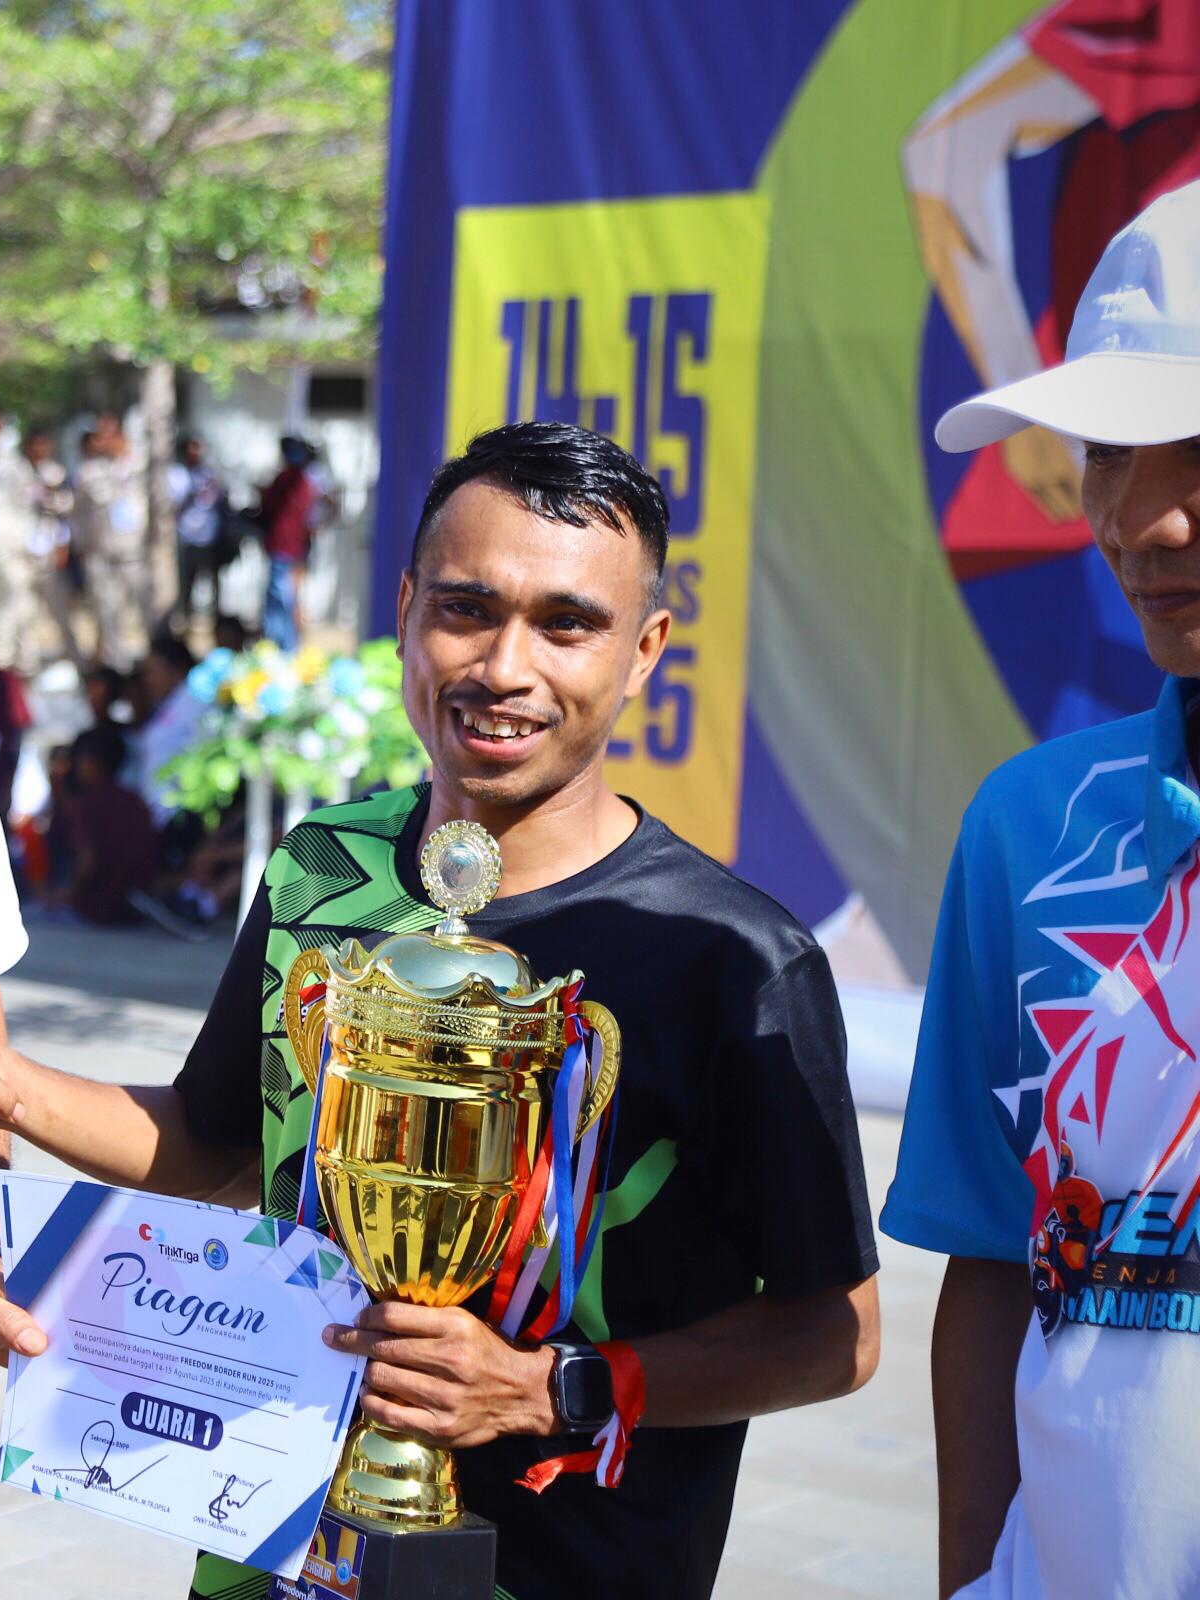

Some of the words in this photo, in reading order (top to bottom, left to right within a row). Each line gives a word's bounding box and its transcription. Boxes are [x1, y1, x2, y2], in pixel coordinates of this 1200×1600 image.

[158, 1243, 199, 1264] TitikTiga
[101, 1252, 269, 1336] Piagam
[196, 1324, 247, 1342] PENGHARGAAN
[73, 1343, 113, 1359] dilaksanakan
[113, 1354, 129, 1364] pada
[130, 1358, 154, 1370] tanggal
[155, 1363, 173, 1375] 14-15
[173, 1367, 198, 1381] Agustus
[199, 1374, 215, 1386] 2025
[215, 1380, 222, 1388] di
[223, 1382, 257, 1397] Kabupaten
[74, 1330, 88, 1341] Atas
[88, 1335, 131, 1351] partisipasinya
[132, 1344, 152, 1356] dalam
[152, 1349, 180, 1362] kegiatan
[180, 1356, 213, 1371] FREEDOM
[213, 1364, 241, 1379] BORDER
[242, 1372, 257, 1383] RUN
[257, 1377, 274, 1387] 2025
[275, 1382, 291, 1393] yang
[115, 1440, 130, 1450] BNPP
[131, 1398, 196, 1442] JUARA
[202, 1417, 214, 1447] 1
